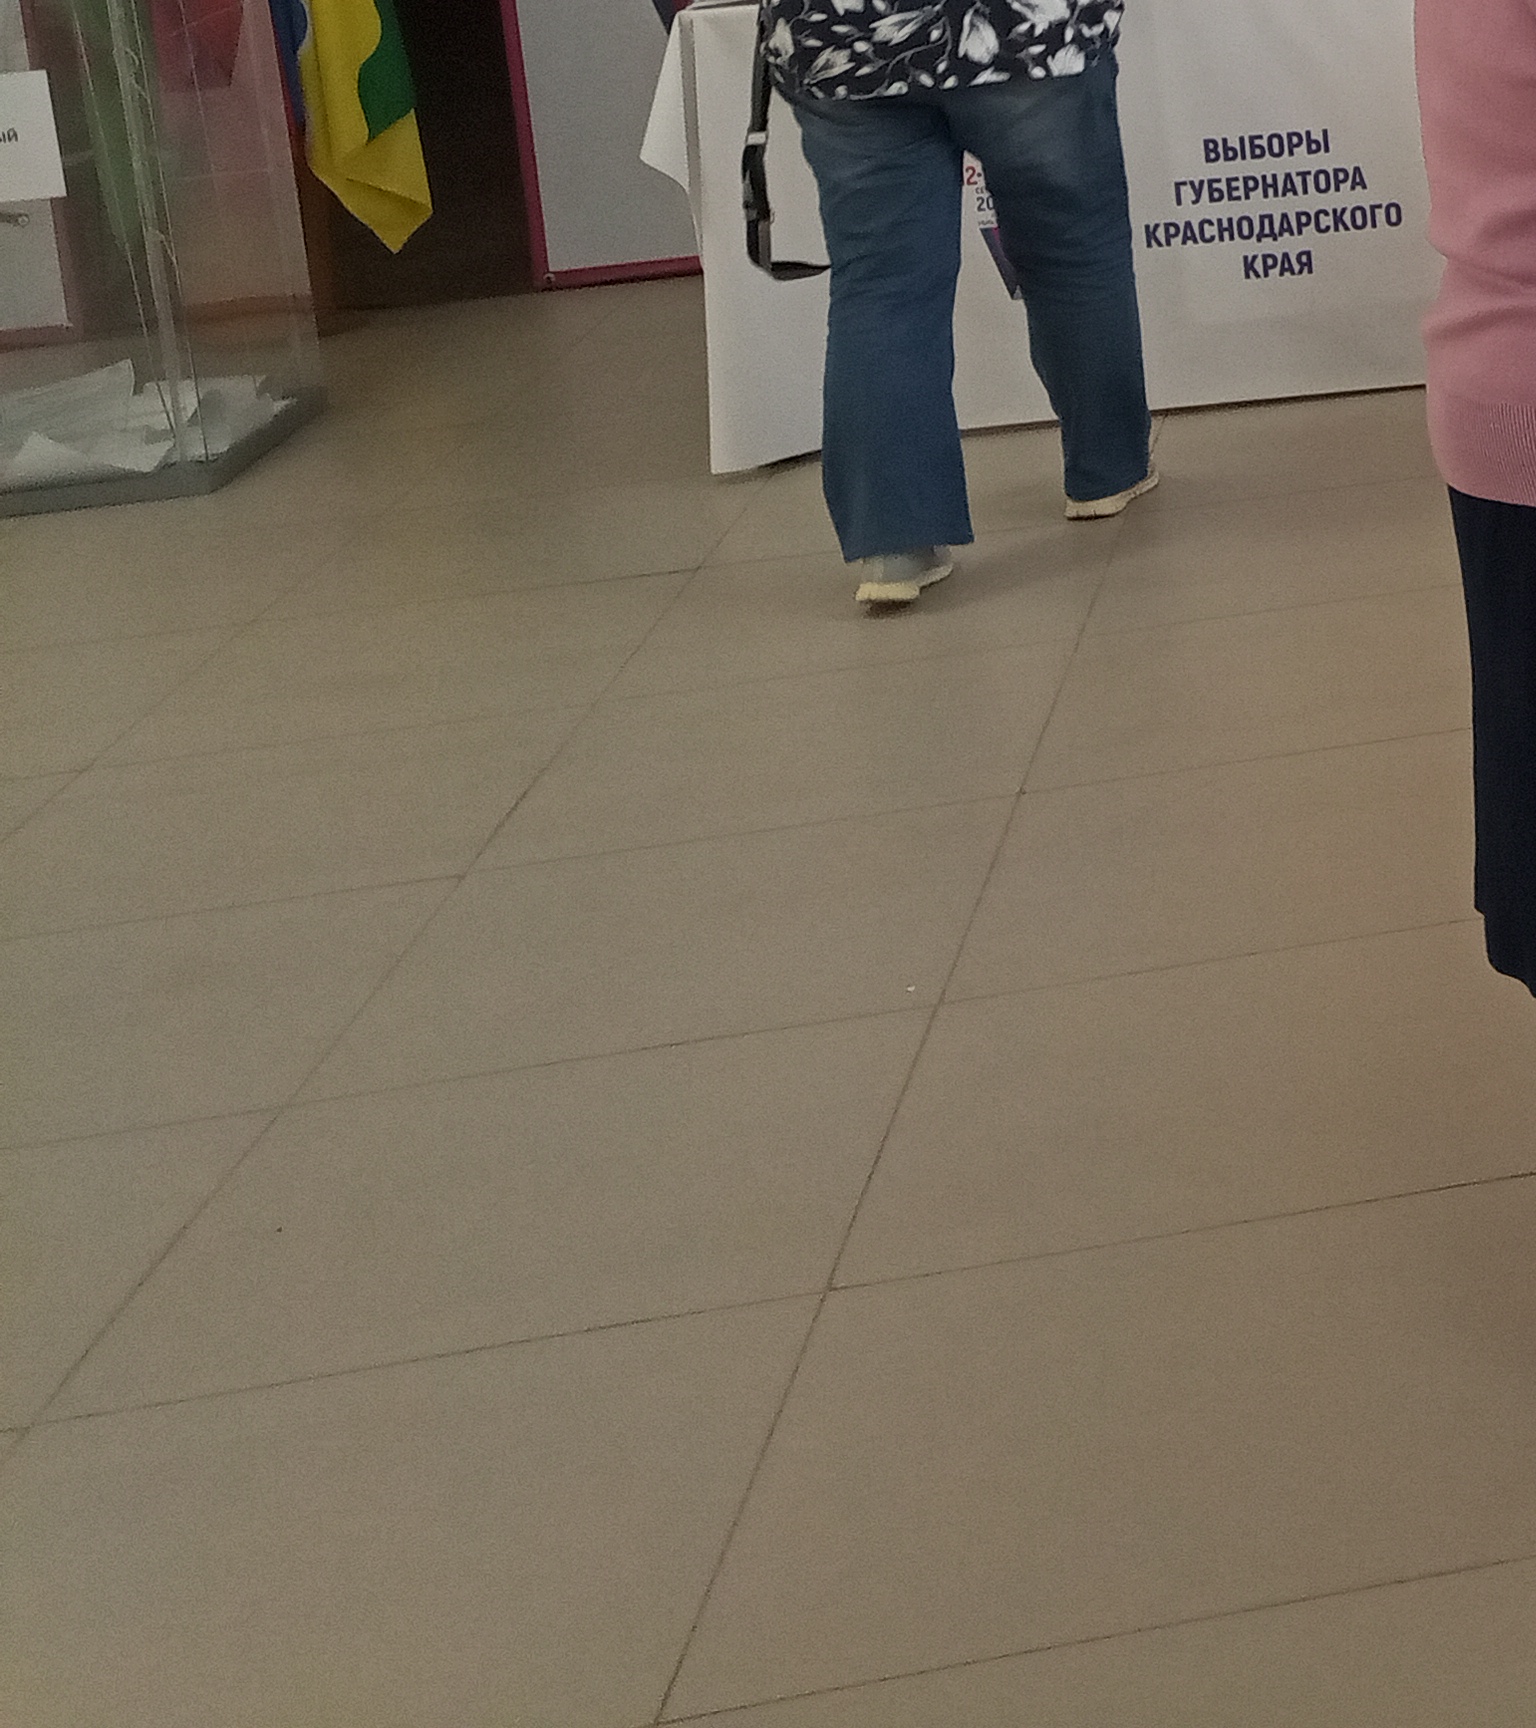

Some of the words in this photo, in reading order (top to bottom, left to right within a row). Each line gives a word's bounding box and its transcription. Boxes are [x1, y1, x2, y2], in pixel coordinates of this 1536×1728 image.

[1203, 128, 1331, 163] ВЫБОРЫ
[1174, 166, 1368, 206] ГУБЕРНАТОРА
[1144, 202, 1403, 249] КРАСНОДАРСКОГО
[1242, 249, 1314, 280] КРАЯ
